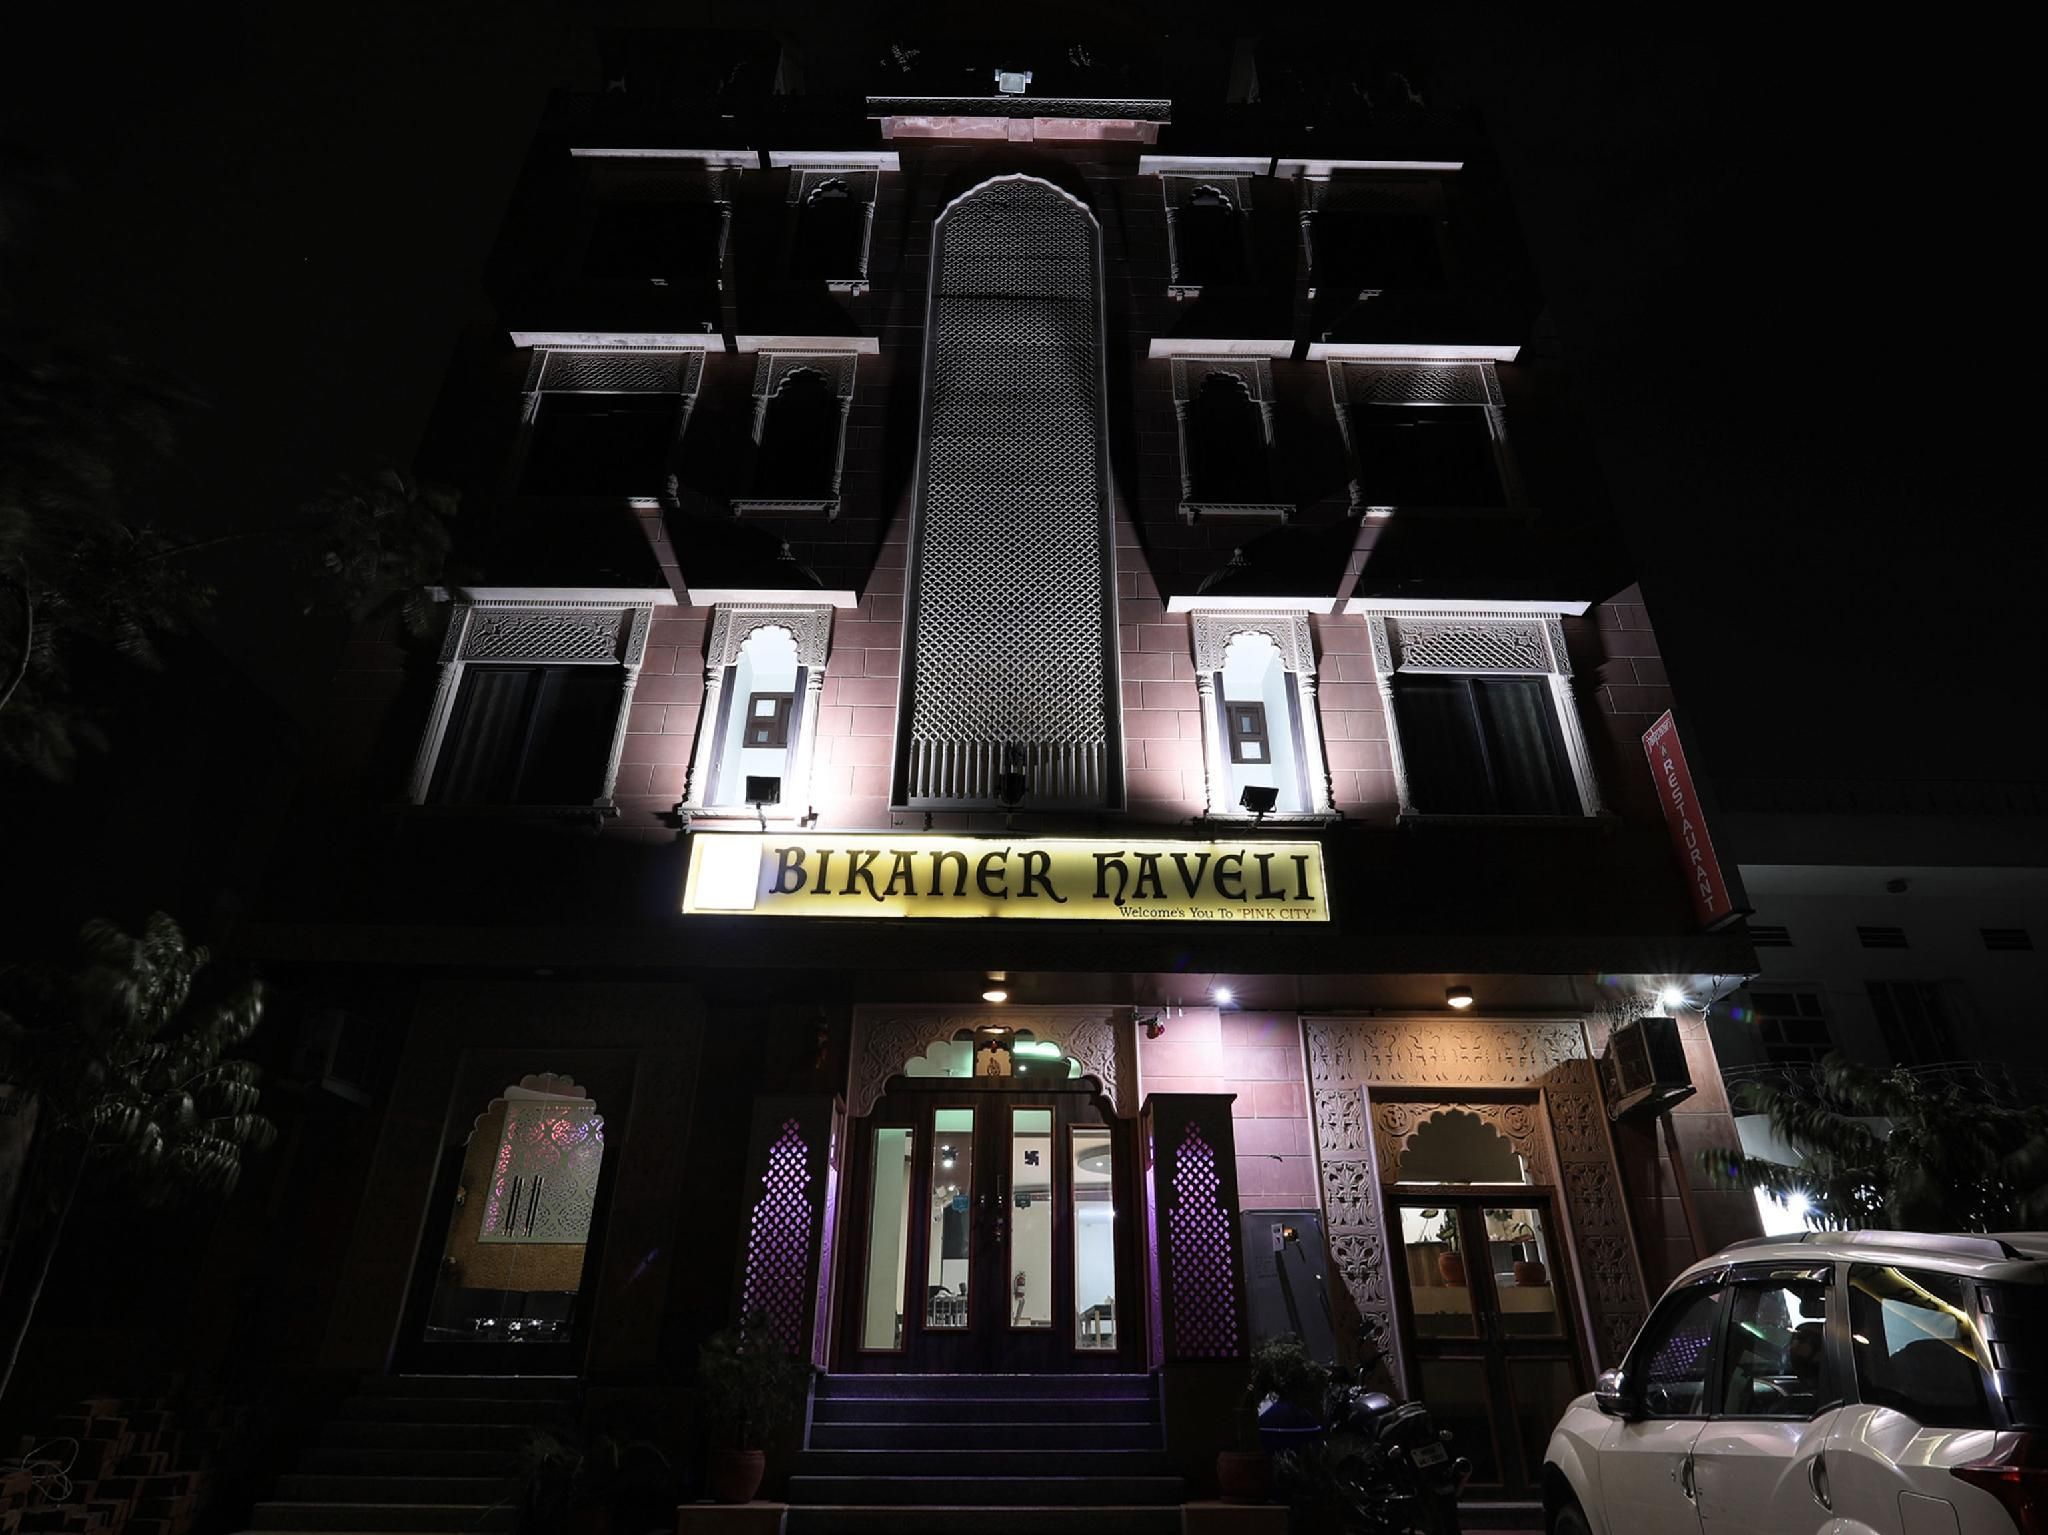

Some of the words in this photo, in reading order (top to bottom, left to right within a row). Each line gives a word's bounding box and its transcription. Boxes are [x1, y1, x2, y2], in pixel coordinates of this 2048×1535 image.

[1663, 759, 1714, 911] RESTAURANT
[769, 847, 1068, 902] BIKANER
[1119, 906, 1185, 919] Welcome's
[1189, 907, 1214, 919] You
[1218, 907, 1234, 919] To
[1236, 908, 1276, 920] "PINK
[1279, 908, 1317, 920] CITY"
